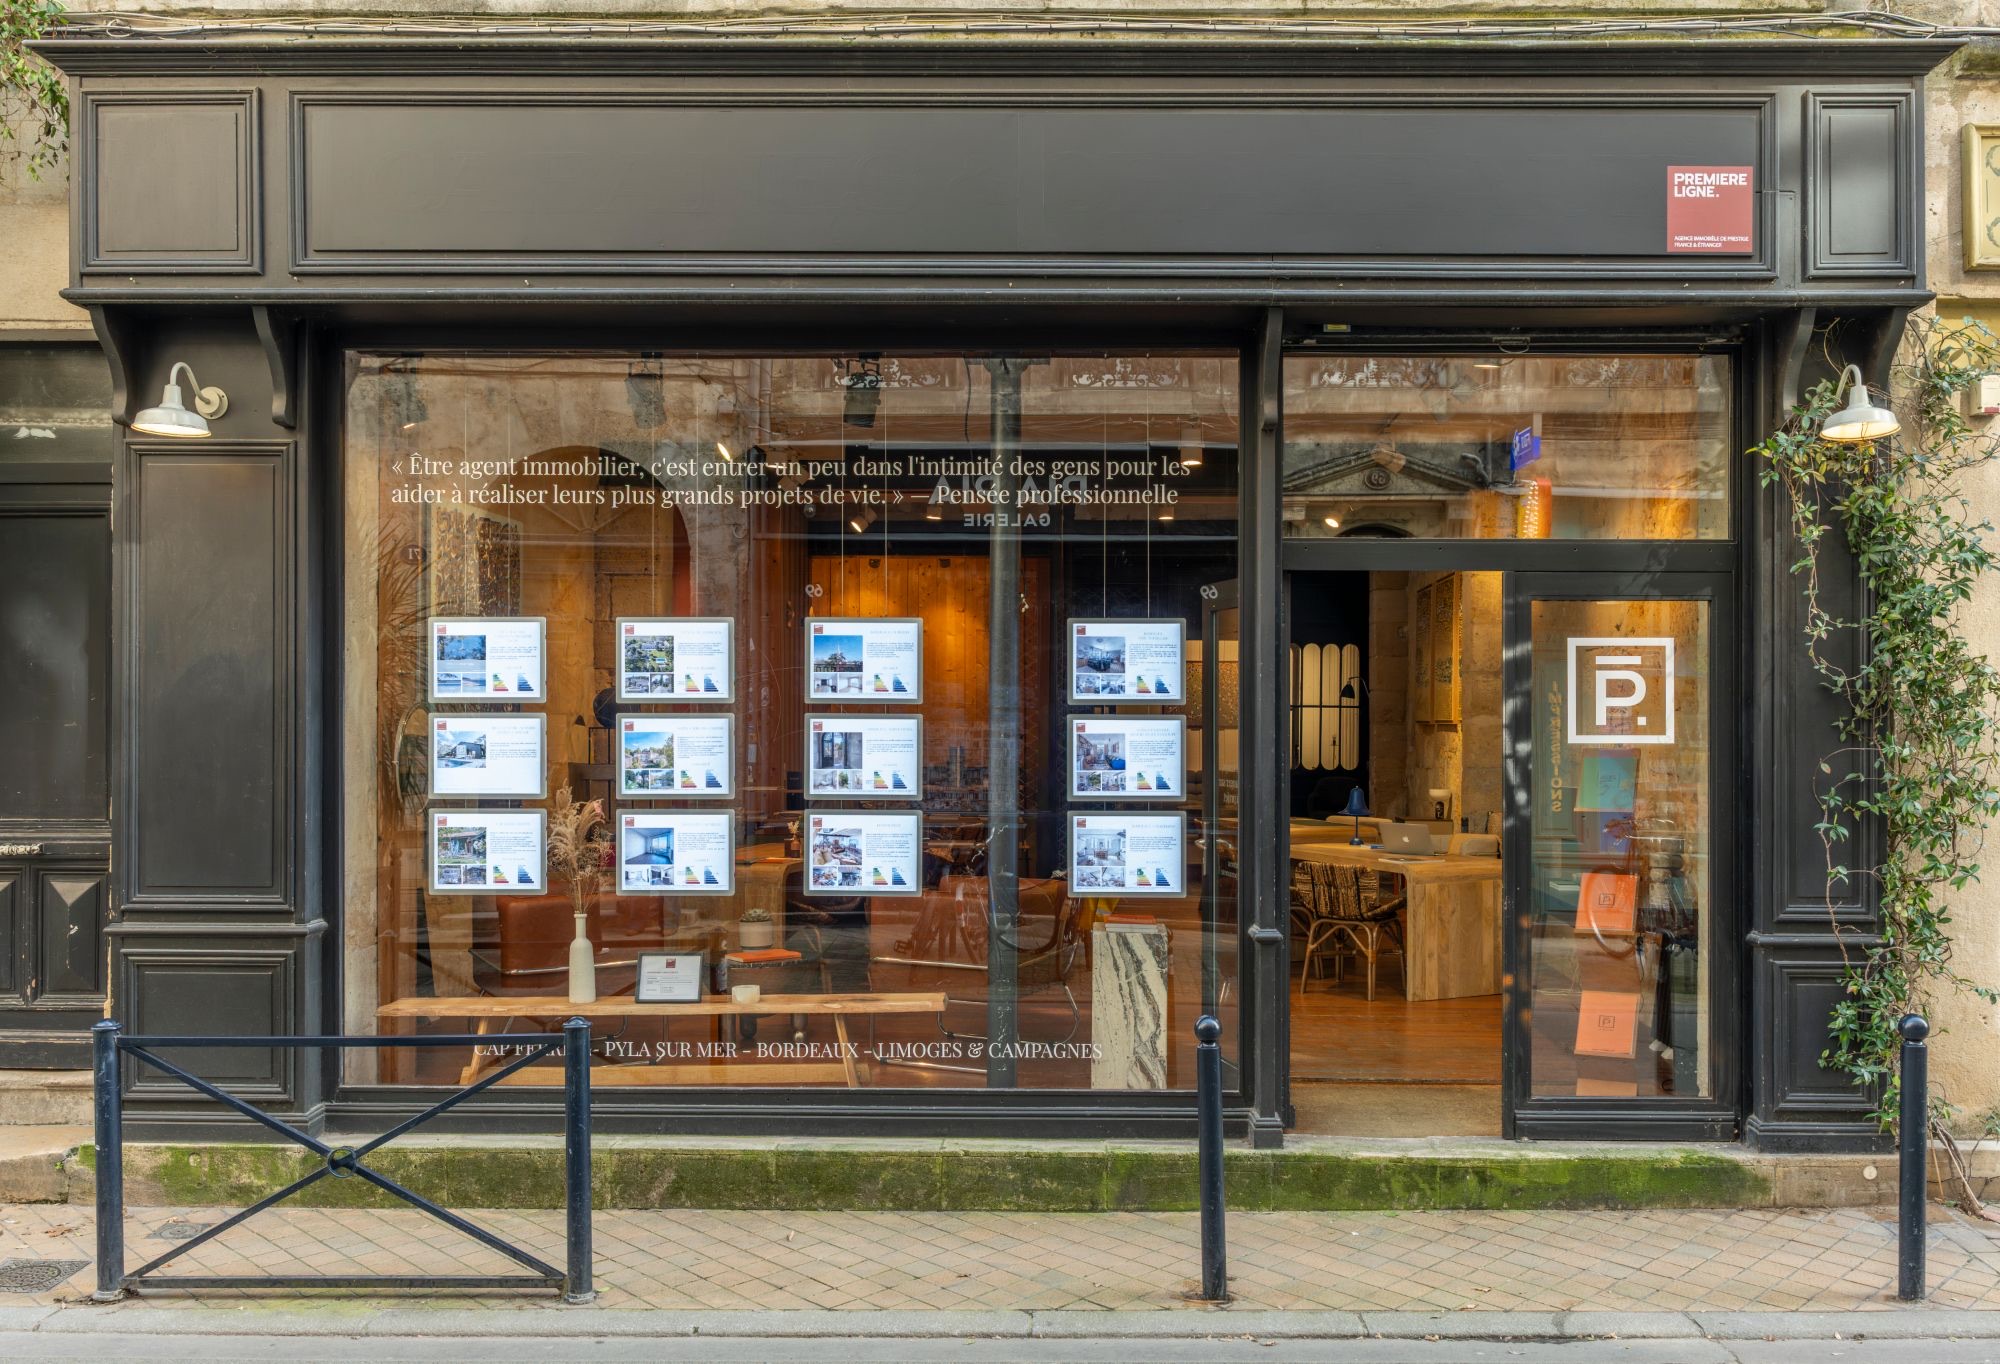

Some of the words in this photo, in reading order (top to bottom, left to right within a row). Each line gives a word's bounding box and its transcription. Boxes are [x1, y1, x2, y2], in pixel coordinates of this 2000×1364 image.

[1674, 173, 1747, 185] PREMIERE
[1674, 186, 1720, 197] LIGNE.
[409, 452, 453, 475] Être
[459, 459, 518, 480] agent
[522, 456, 645, 480] immobilier,
[651, 457, 698, 476] c'est
[702, 459, 769, 476] entrer
[776, 462, 802, 476] un
[808, 460, 847, 480] peu
[853, 456, 903, 476] dans
[908, 455, 1004, 476] l'intimité
[1009, 456, 1046, 476] des
[1051, 460, 1100, 480] gens
[1106, 460, 1158, 480] pour
[1162, 456, 1191, 476] les
[391, 484, 446, 504] aider
[451, 483, 462, 504] à
[469, 483, 548, 504] réaliser
[553, 484, 605, 504] leurs
[611, 484, 656, 508] plus
[661, 484, 734, 509] grands
[740, 485, 814, 509] projets
[820, 484, 849, 504] de
[850, 485, 887, 504] vie.
[936, 483, 1010, 504] Pensée
[1016, 484, 1179, 508] professionnelle
[605, 1042, 652, 1057] PYLA
[656, 1041, 692, 1058] SUR
[697, 1042, 738, 1057] MER
[757, 1042, 859, 1058] BORDEAUX
[878, 1042, 963, 1058] LIMOGES
[967, 1042, 984, 1058] &
[988, 1042, 1102, 1058] CAMPAGNES
